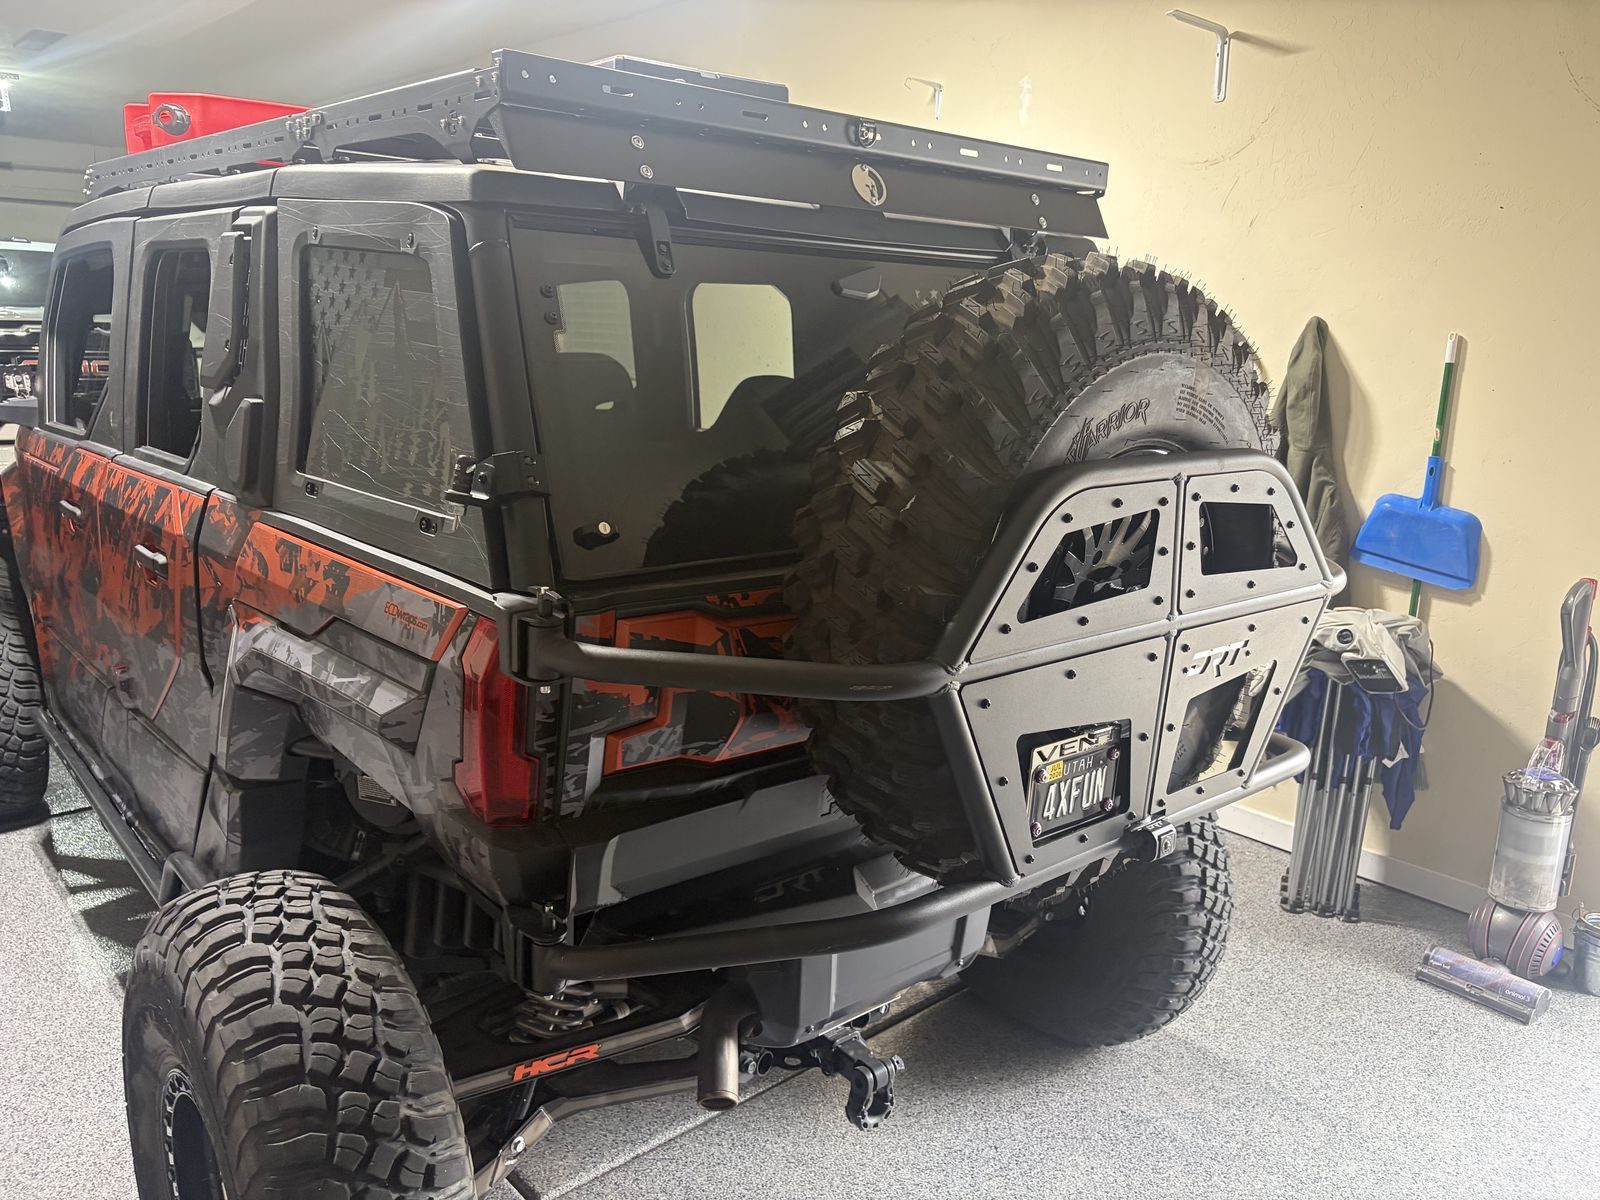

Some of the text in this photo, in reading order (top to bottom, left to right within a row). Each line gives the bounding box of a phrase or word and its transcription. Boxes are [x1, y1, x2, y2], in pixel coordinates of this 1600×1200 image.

[1063, 755, 1094, 775] UTAH
[1043, 765, 1108, 820] 4XFUN
[1505, 989, 1526, 1000] animal
[513, 1044, 600, 1081] HCR
